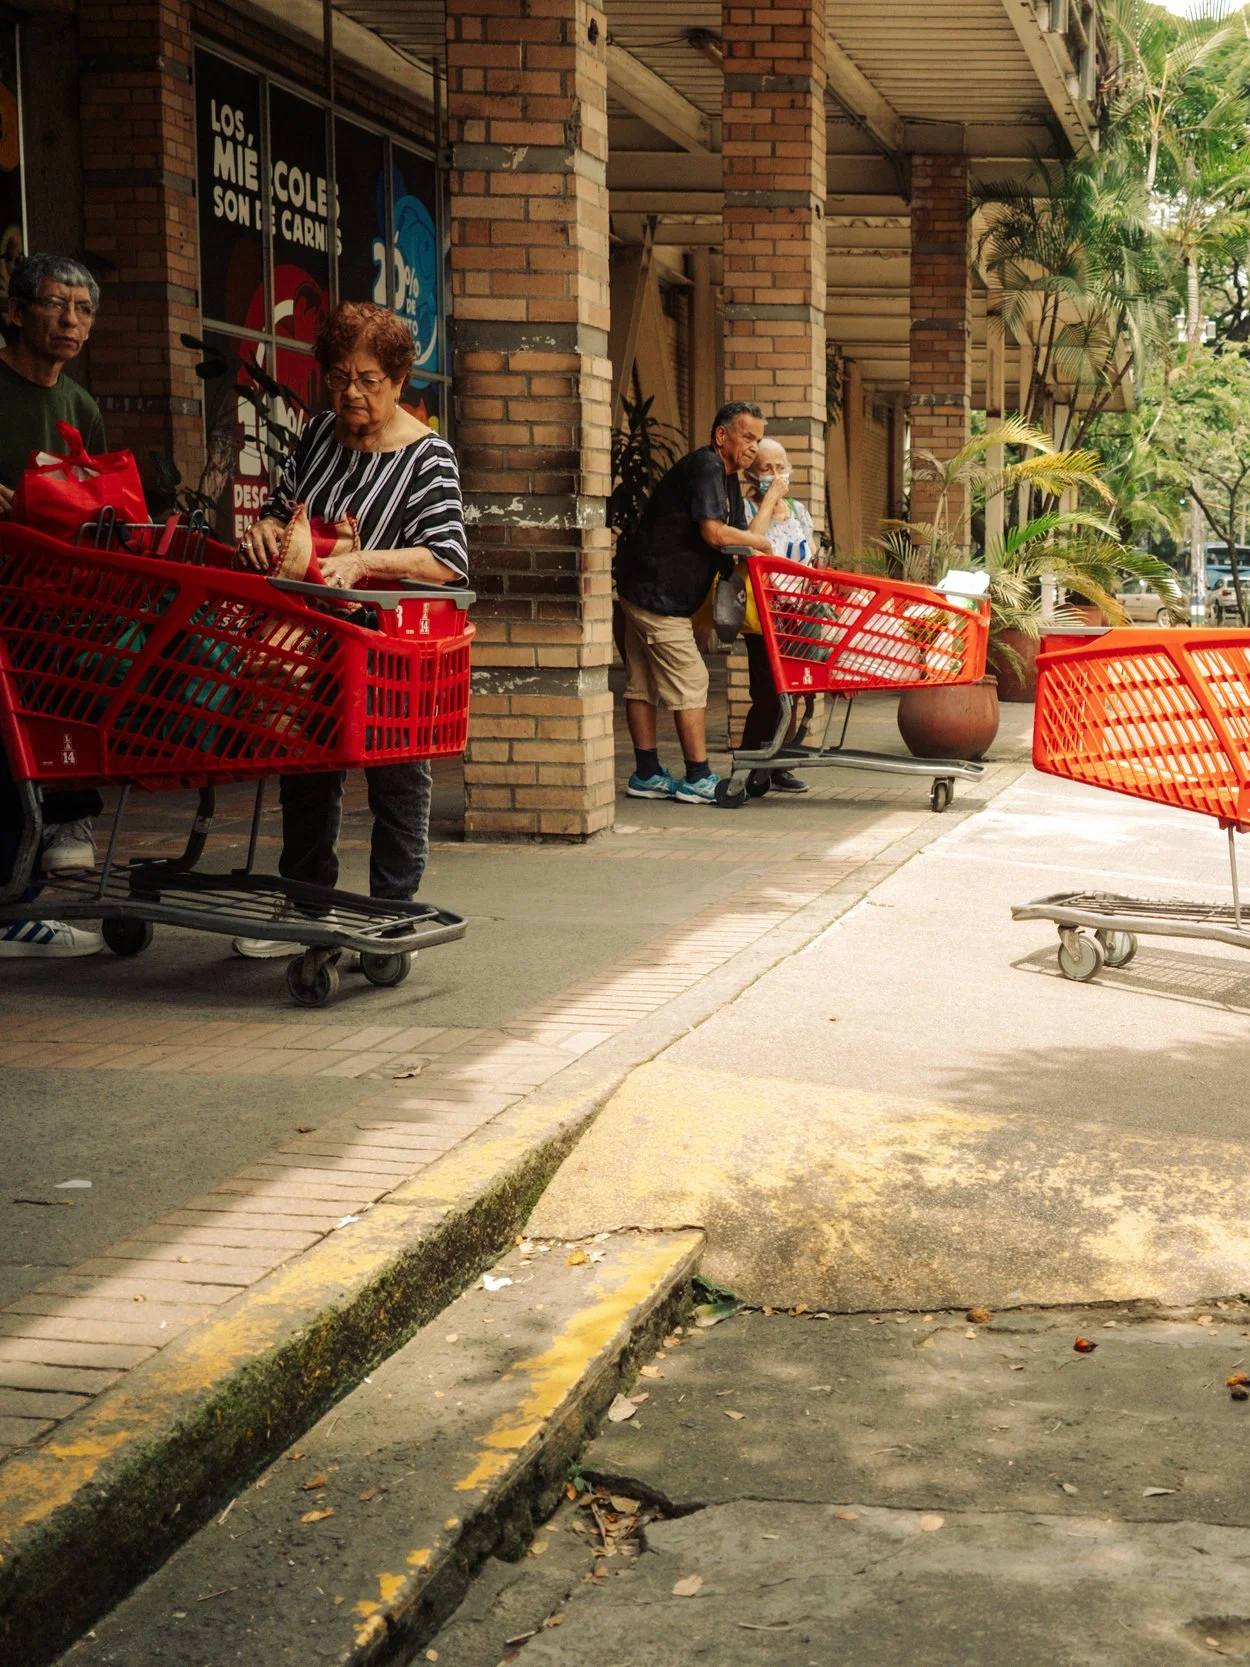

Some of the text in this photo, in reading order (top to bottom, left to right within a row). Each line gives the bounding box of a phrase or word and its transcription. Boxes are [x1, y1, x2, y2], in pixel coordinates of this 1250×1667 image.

[211, 98, 245, 142] LOS
[213, 133, 341, 221] MIÉCOLE
[213, 184, 250, 227] SON
[281, 209, 343, 257] CARNS
[406, 298, 417, 316] DE
[62, 751, 76, 764] 14
